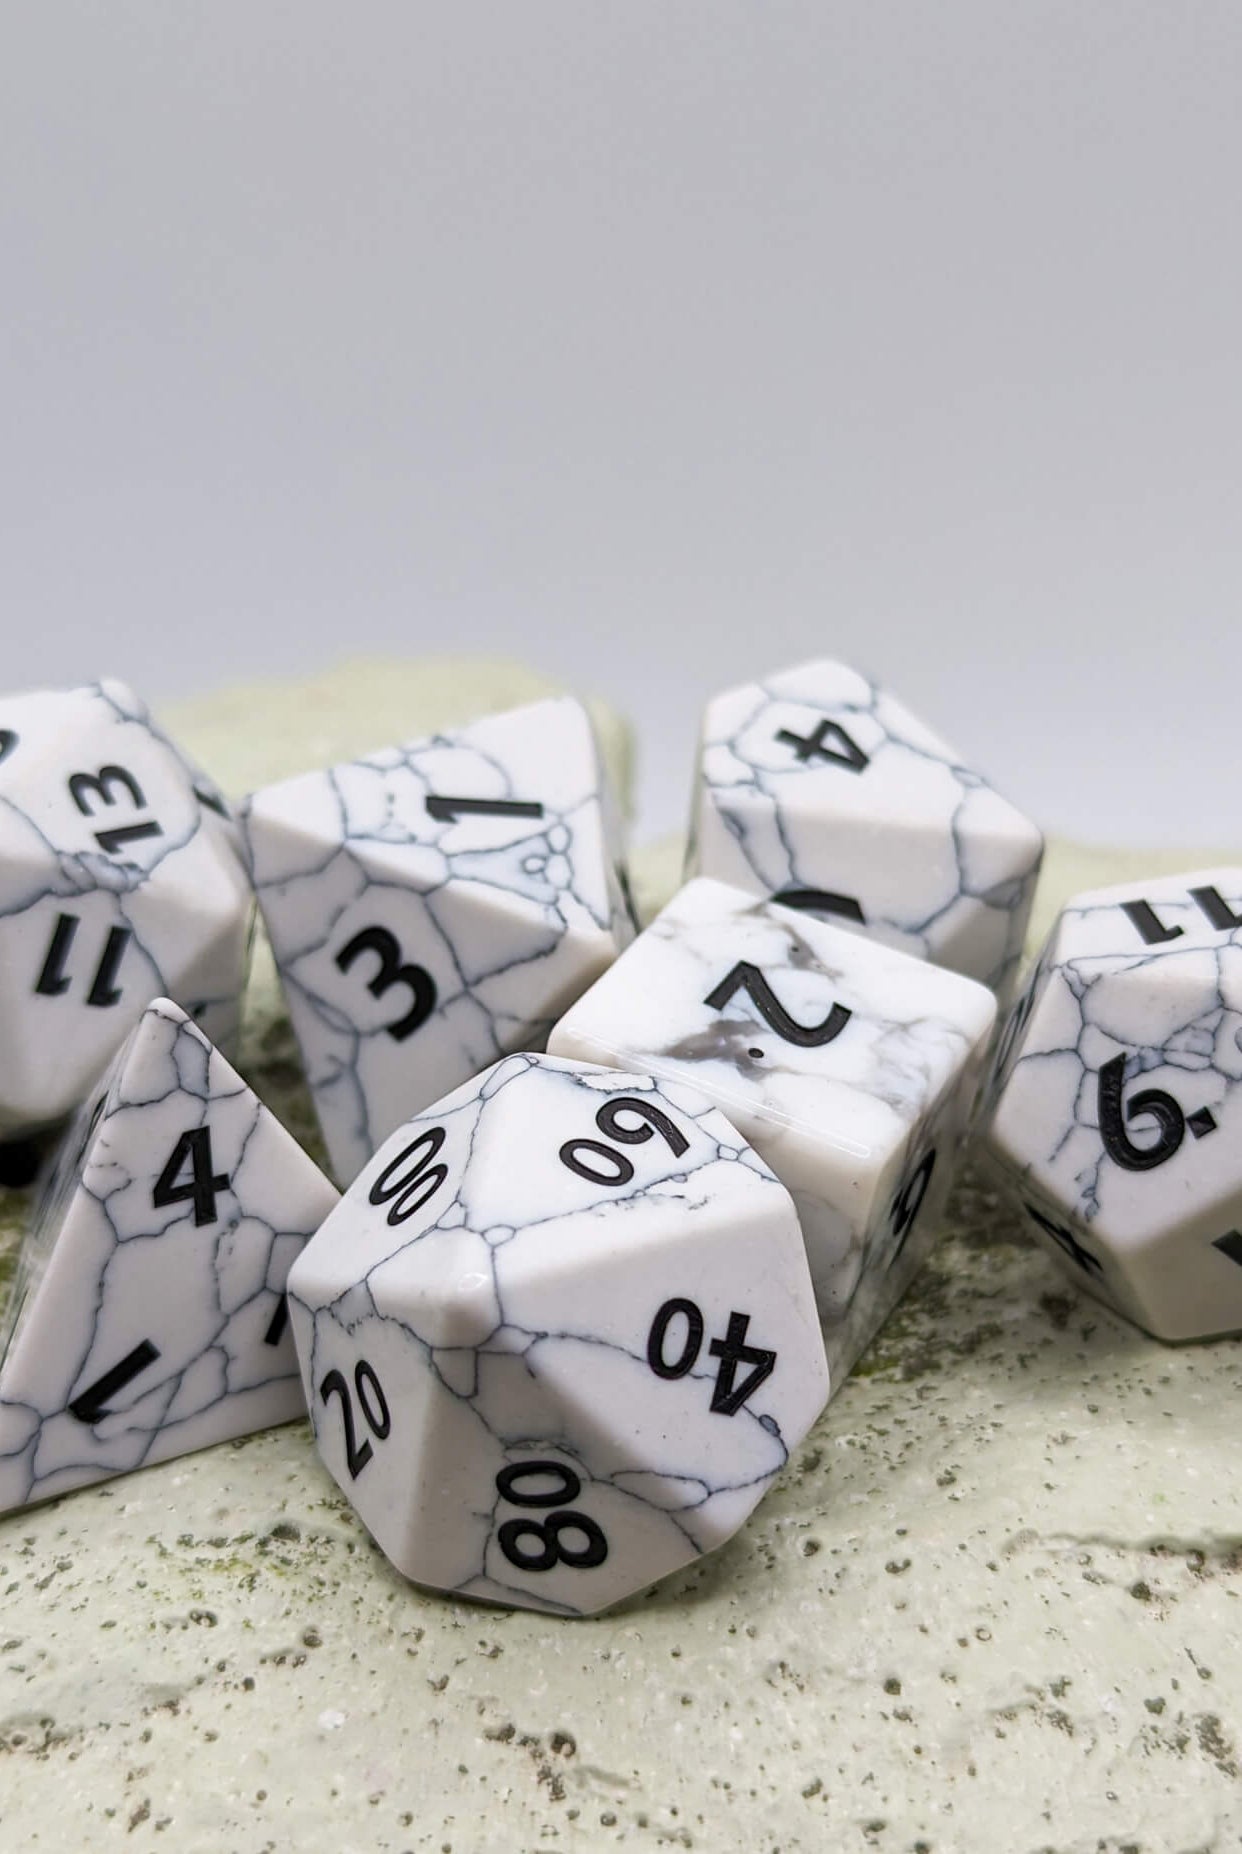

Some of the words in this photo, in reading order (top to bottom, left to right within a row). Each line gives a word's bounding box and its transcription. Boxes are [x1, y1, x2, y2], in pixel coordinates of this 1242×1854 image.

[774, 718, 870, 776] 4
[69, 765, 164, 855] 13
[425, 794, 543, 824] 1
[34, 912, 132, 1007] 11
[1119, 885, 1242, 945] 11
[334, 925, 438, 1044] 3
[703, 959, 853, 1048] 2
[153, 1125, 231, 1228] 4
[369, 1126, 448, 1227] 00
[558, 1096, 690, 1187] 60
[67, 1337, 163, 1425] 1
[647, 1297, 777, 1417] 40
[320, 1359, 391, 1480] 20
[496, 1460, 609, 1573] 80
